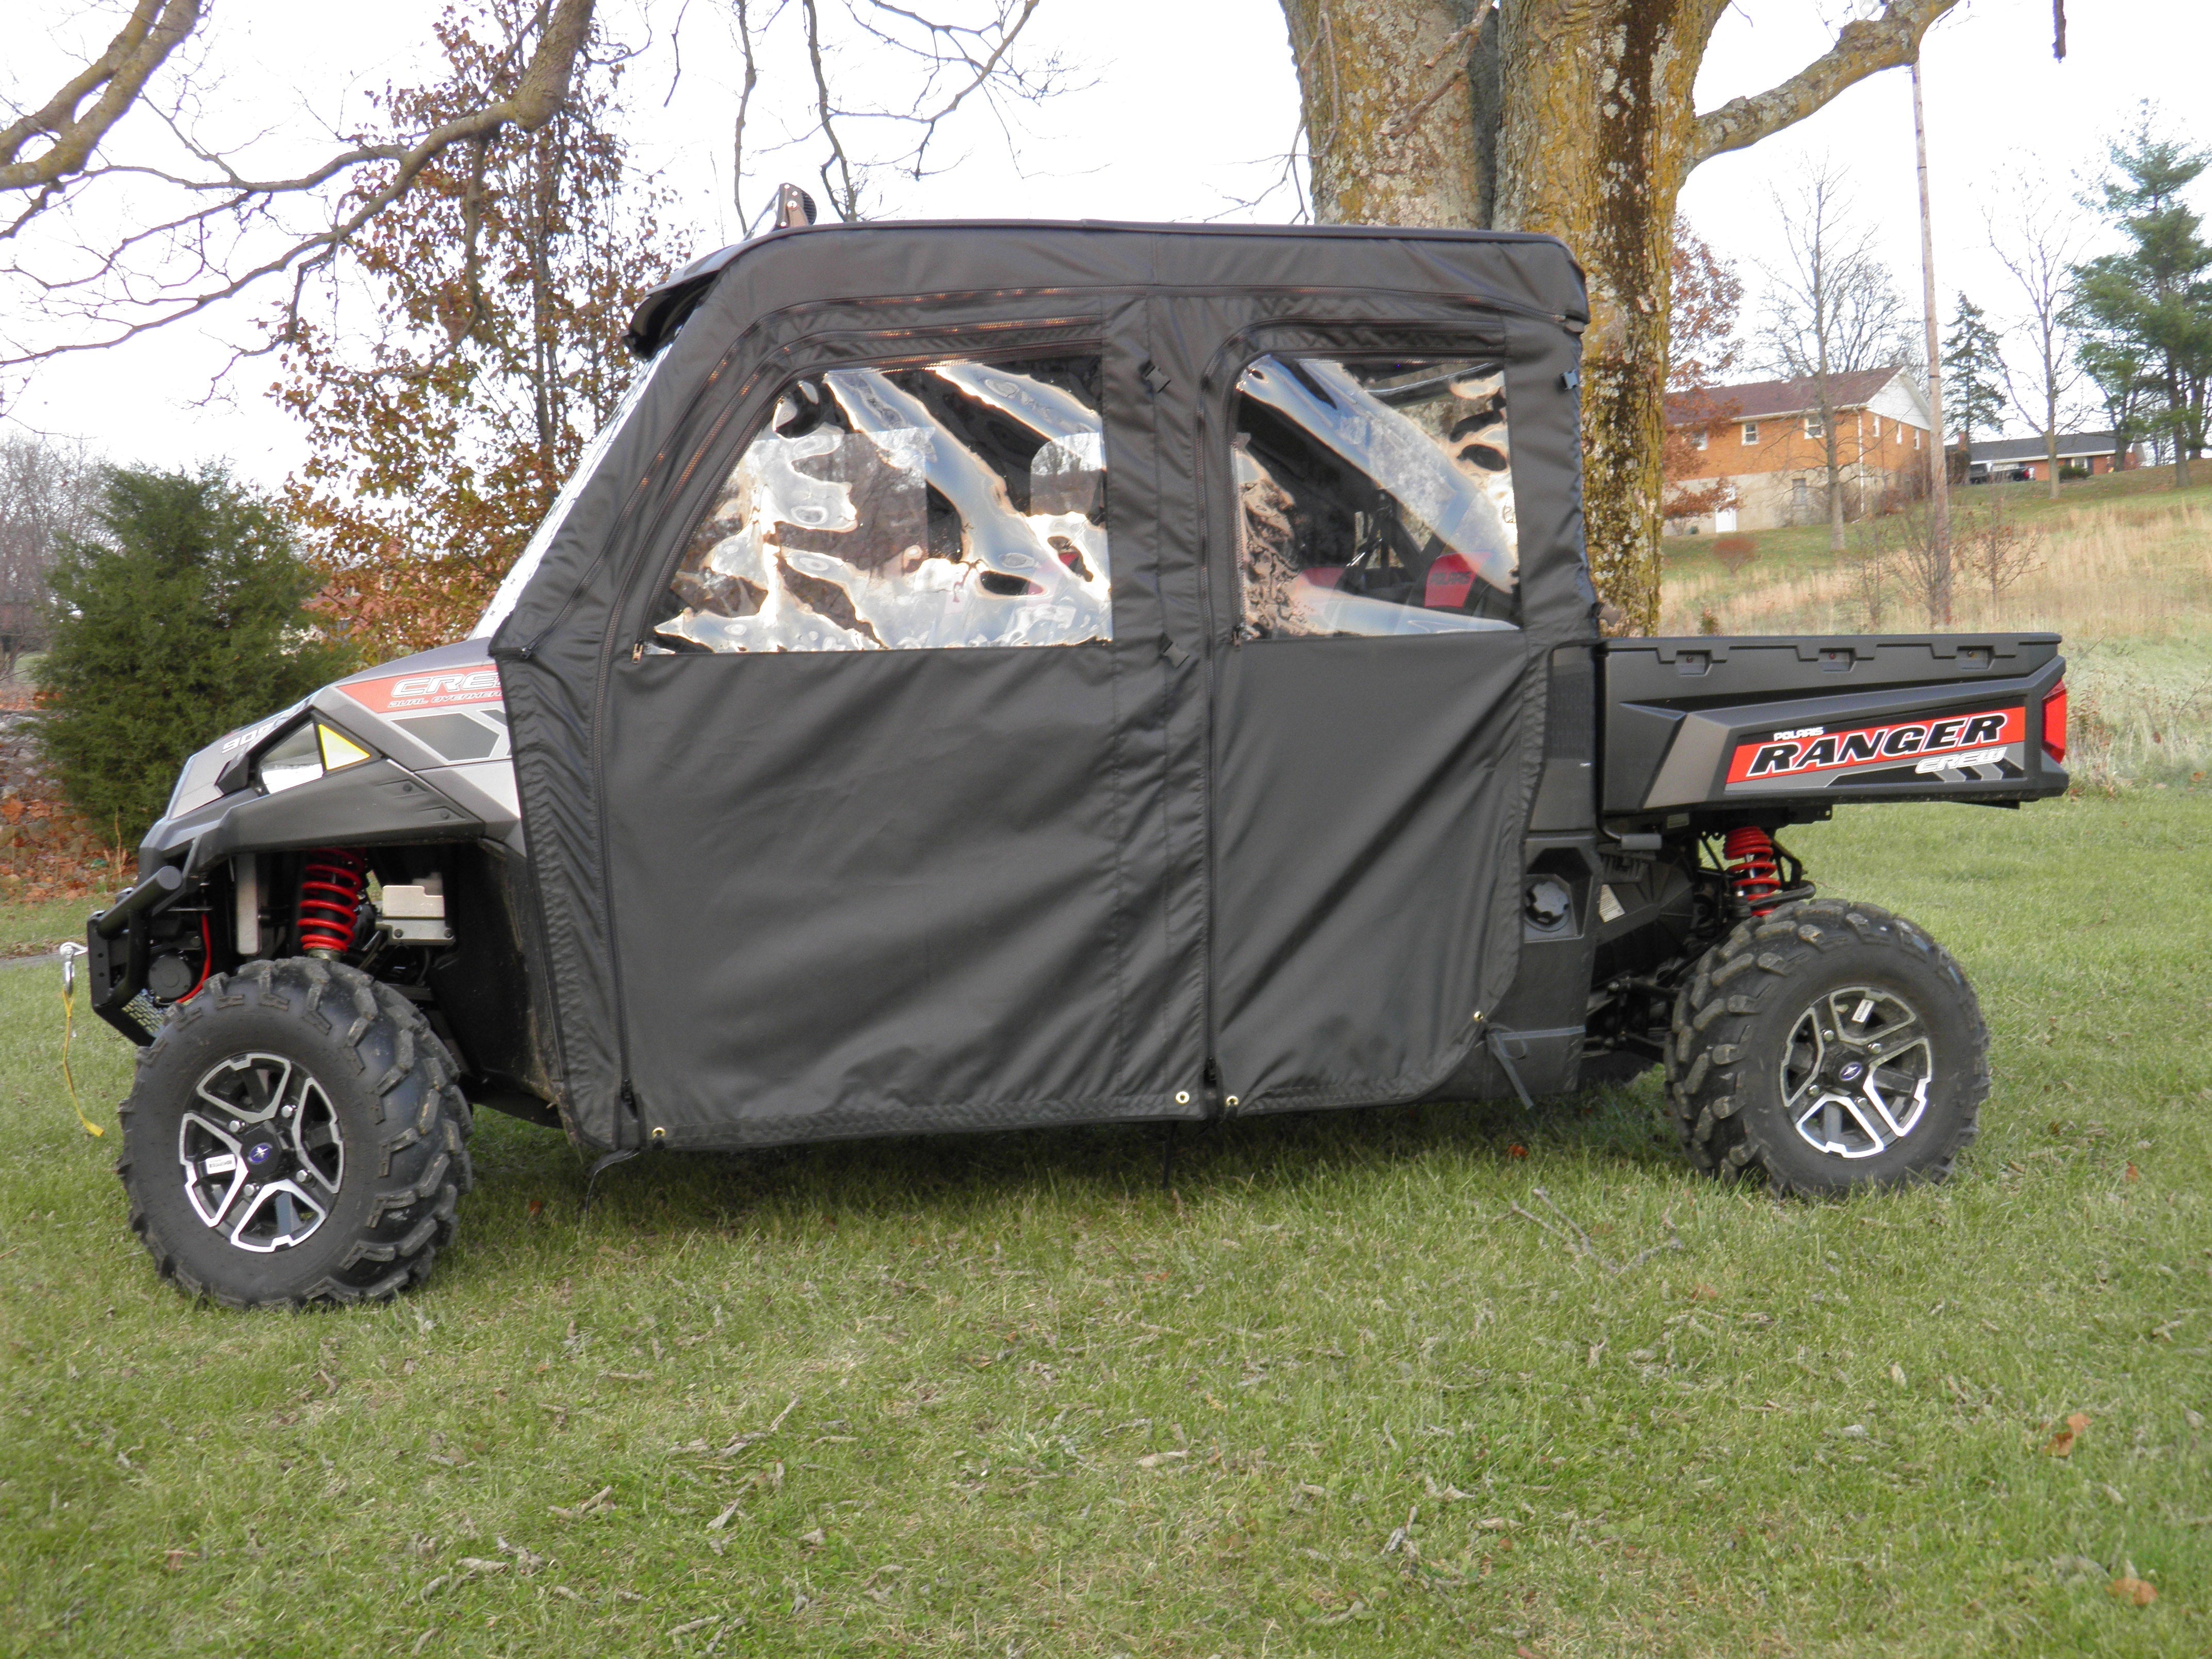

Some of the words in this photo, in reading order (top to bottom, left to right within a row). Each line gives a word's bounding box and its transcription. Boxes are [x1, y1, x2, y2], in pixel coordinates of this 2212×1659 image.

[391, 672, 501, 697] CRE
[388, 698, 428, 708] DUAL
[431, 690, 502, 703] OVERHEA
[1746, 713, 2008, 777] RANGER
[1774, 726, 1825, 741] POLARIS
[1915, 747, 2008, 774] CREW
